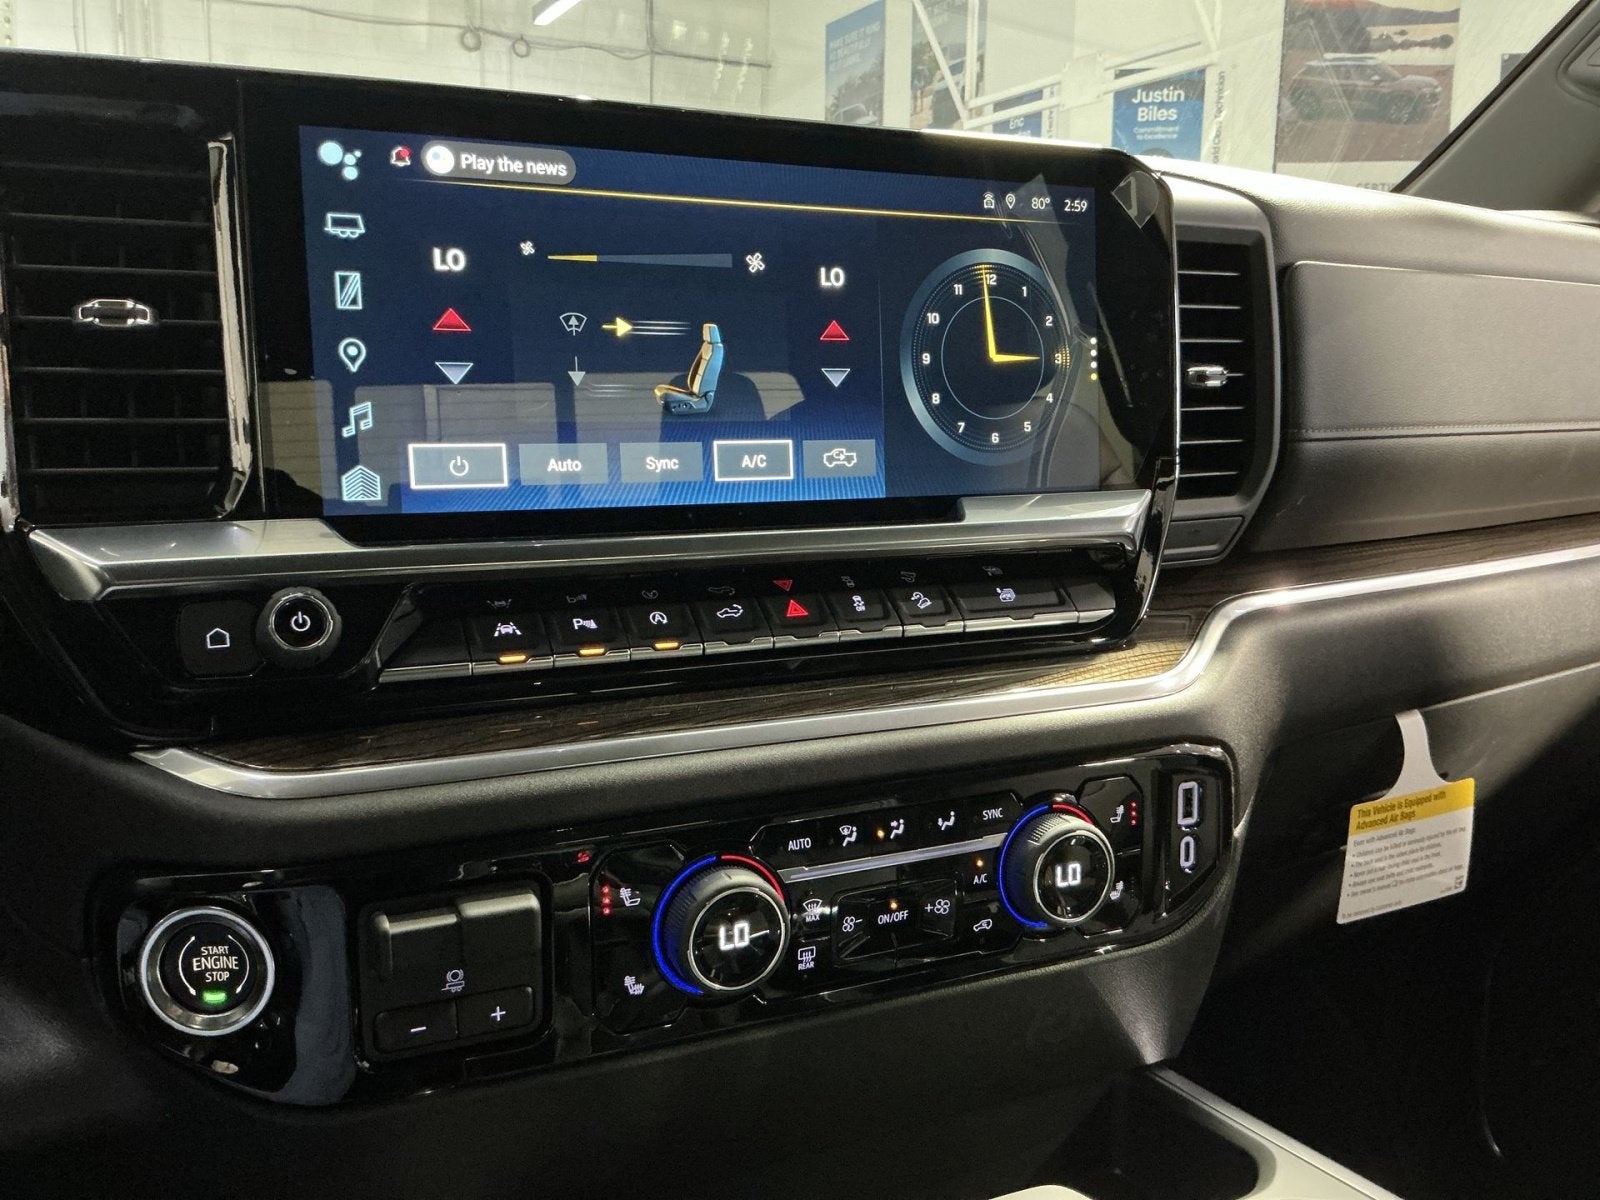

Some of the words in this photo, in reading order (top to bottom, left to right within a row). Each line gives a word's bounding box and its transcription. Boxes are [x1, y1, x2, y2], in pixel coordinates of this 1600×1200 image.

[1131, 86, 1186, 104] Justin
[1137, 105, 1178, 122] Biles
[460, 154, 496, 175] Play
[499, 156, 523, 173] the
[526, 161, 567, 177] news
[1064, 199, 1088, 213] 2:59
[433, 247, 466, 272] LO
[820, 266, 845, 287] LO
[986, 274, 997, 285] 12
[953, 284, 963, 295] 11
[1022, 286, 1027, 297] 1
[927, 313, 939, 324] 10
[1045, 315, 1053, 326] 2
[922, 353, 930, 364] 9
[1055, 353, 1062, 364] 3
[931, 393, 940, 404] 8
[1045, 392, 1053, 403] 4
[957, 422, 965, 434] 7
[1023, 421, 1031, 431] 5
[991, 433, 999, 443] 6
[547, 458, 582, 472] Auto
[646, 456, 679, 471] Sync
[741, 453, 767, 469] A/C
[1358, 808, 1371, 818] This
[1373, 802, 1396, 815] Vehicle
[1397, 801, 1403, 810] is
[1404, 794, 1432, 808] Equipped
[1433, 791, 1446, 801] with
[982, 808, 1004, 821] SYNC
[1356, 813, 1388, 830] Advanced
[1389, 812, 1399, 823] Air
[1400, 810, 1416, 821] Bags
[787, 837, 812, 851] AUTO
[973, 873, 988, 885] A/C
[1055, 862, 1082, 888] LO
[805, 914, 819, 922] MAX
[877, 910, 909, 925] ON/OFF
[719, 921, 750, 951] LO
[201, 946, 229, 955] START
[192, 956, 239, 971] ENGINE
[798, 961, 814, 970] REAR
[205, 971, 230, 982] STOP
